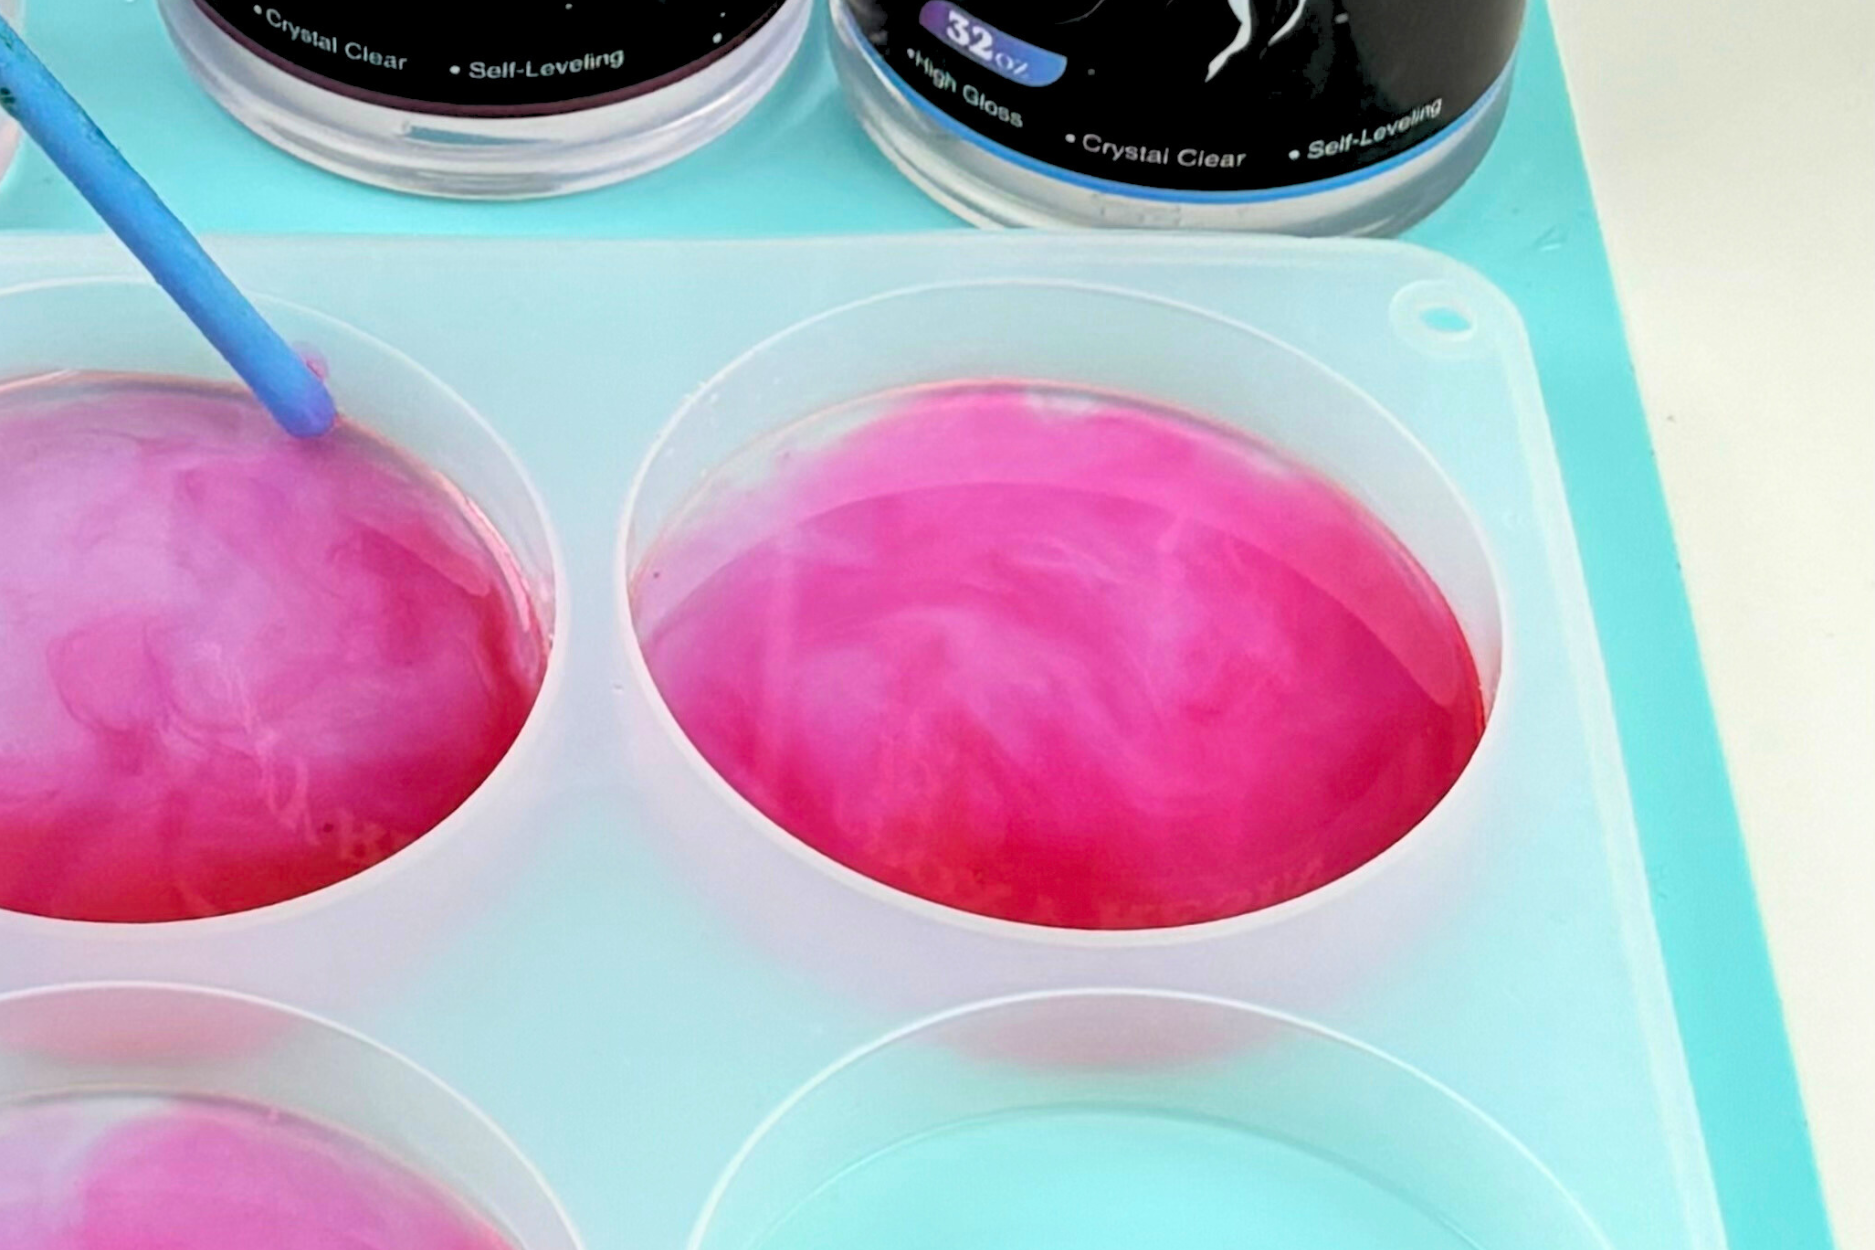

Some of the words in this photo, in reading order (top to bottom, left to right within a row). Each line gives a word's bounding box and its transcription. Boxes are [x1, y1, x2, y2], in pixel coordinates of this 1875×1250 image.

[265, 8, 337, 53] Crystal
[344, 41, 408, 70] Clear
[468, 49, 625, 79] Self-Leveling
[914, 50, 957, 94] High
[962, 84, 1024, 129] Gloss
[1082, 134, 1169, 165] Crystal
[1177, 148, 1247, 169] Clear
[1307, 97, 1443, 160] Self-Leveling
